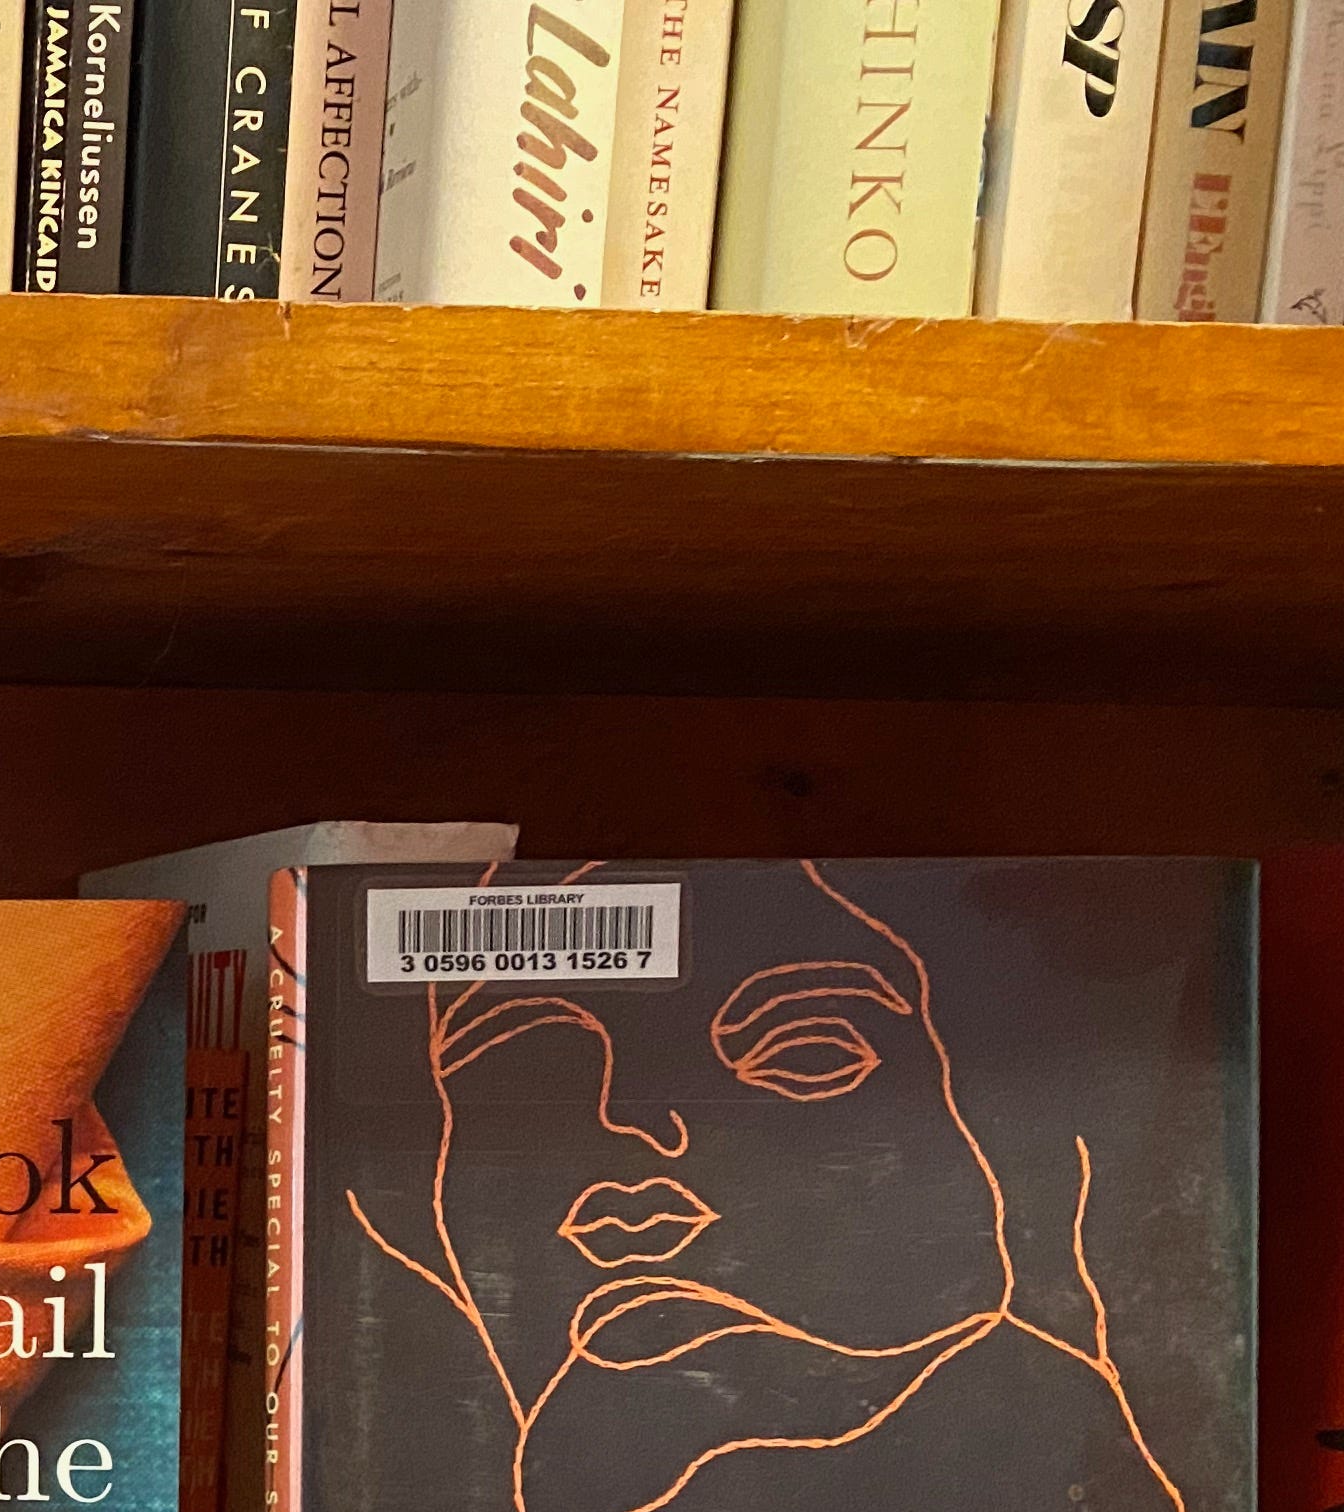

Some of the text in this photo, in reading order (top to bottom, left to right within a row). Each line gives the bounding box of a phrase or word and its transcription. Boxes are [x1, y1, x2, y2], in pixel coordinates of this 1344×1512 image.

[36, 6, 71, 292] JAMAICA KINCAID
[77, 4, 122, 250] Korneliussen
[223, 66, 268, 300] CRANES
[312, 42, 358, 300] AFFECTION
[639, 86, 680, 298] NAMESAKE
[401, 951, 652, 973] 3 0596 0013 1526 7
[470, 893, 584, 906] FORBES LIBRARY
[268, 968, 285, 1124] CRUELTY
[266, 1150, 282, 1293] SPECIAL
[266, 1321, 281, 1366] TO
[265, 1392, 280, 1464] OUR
